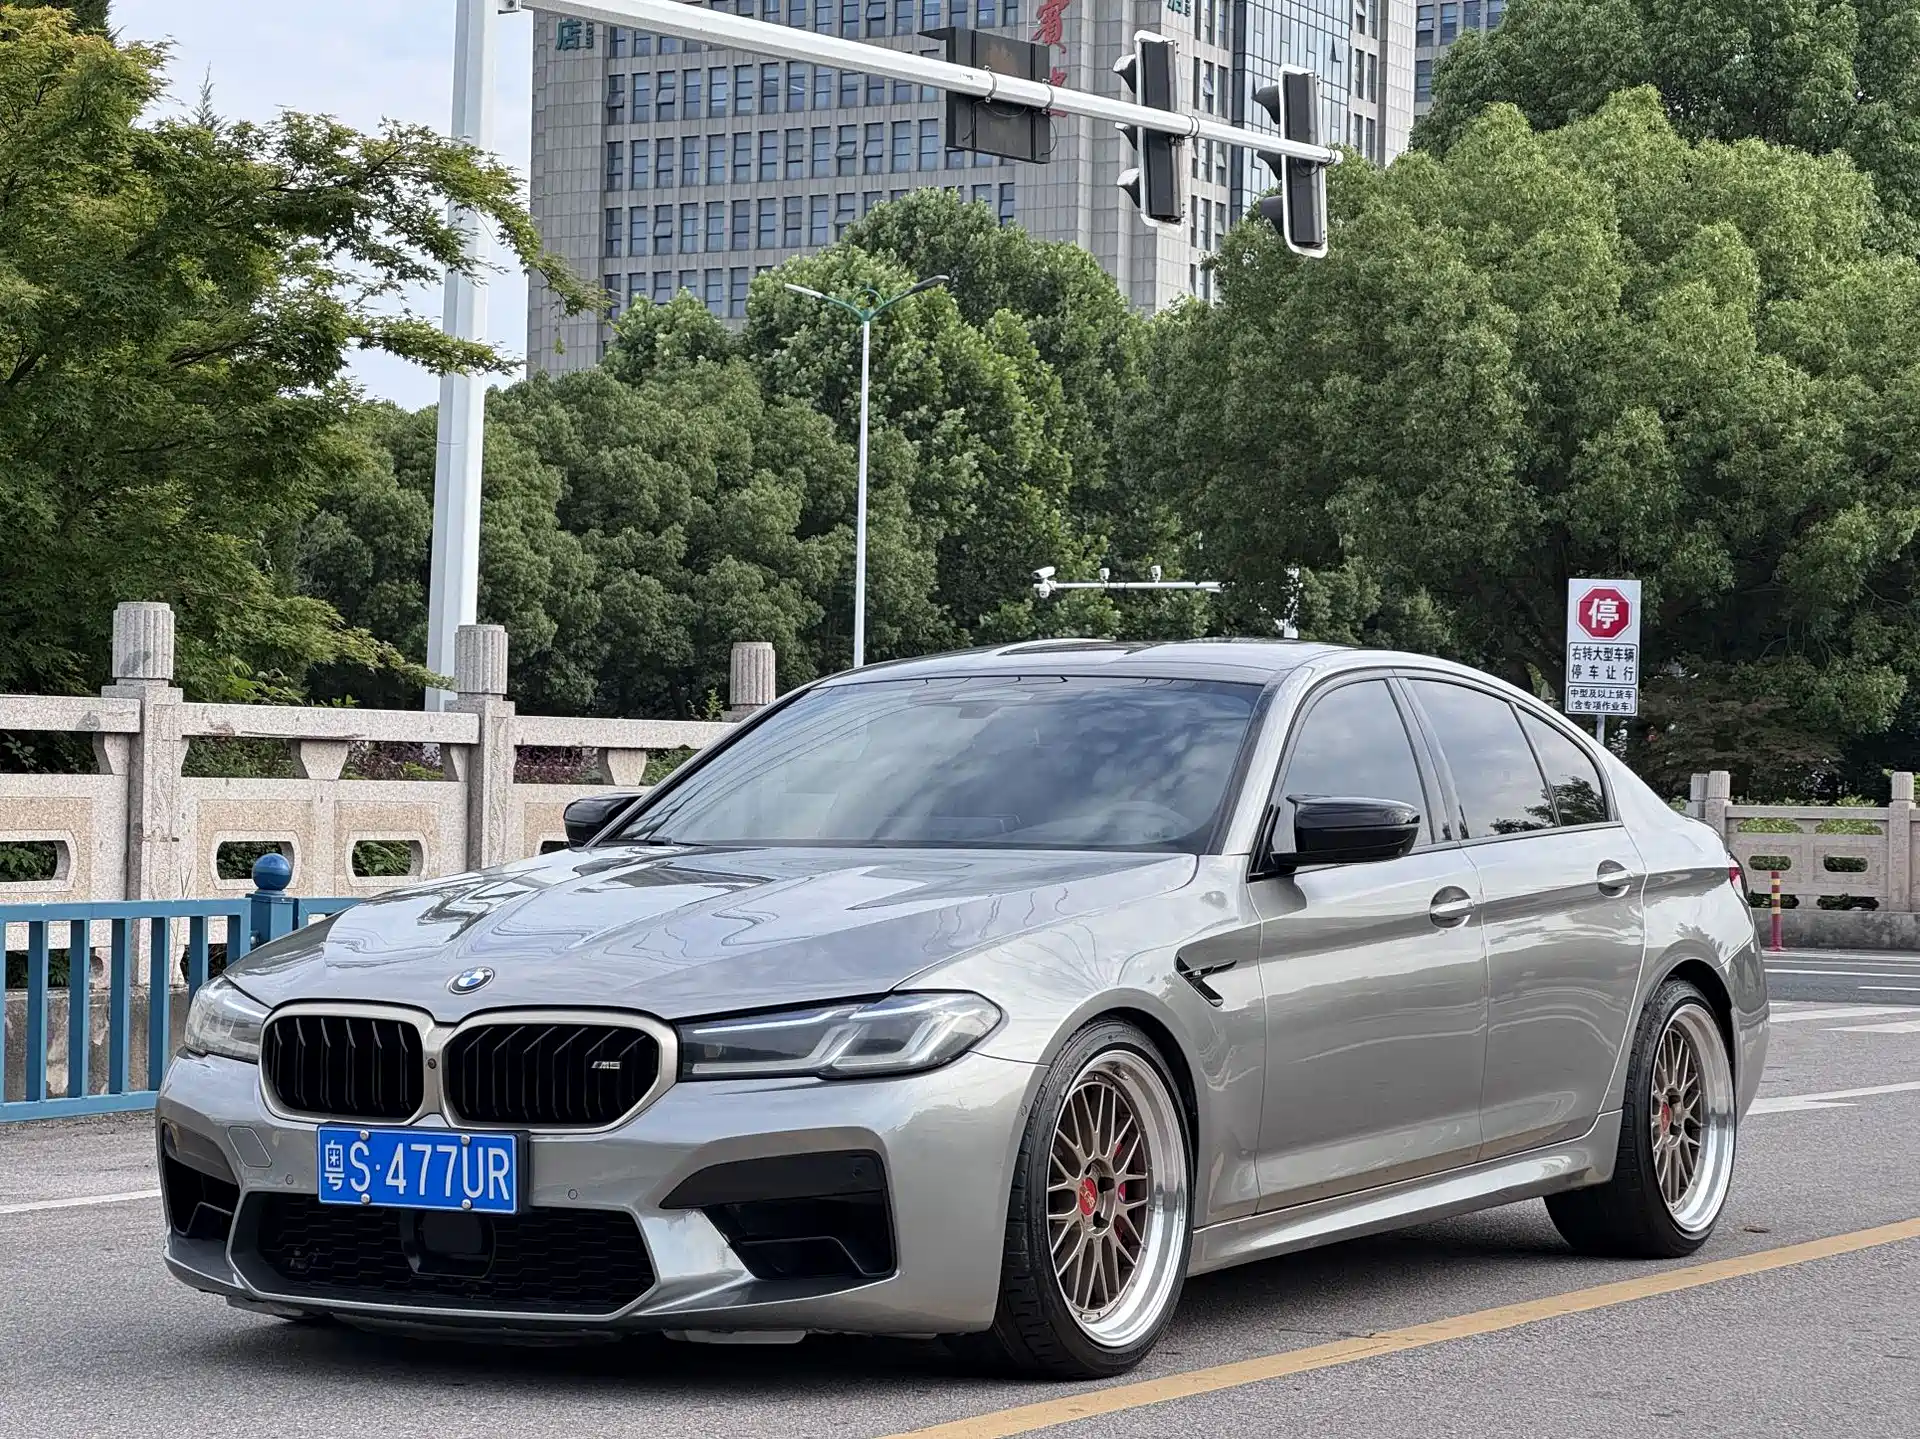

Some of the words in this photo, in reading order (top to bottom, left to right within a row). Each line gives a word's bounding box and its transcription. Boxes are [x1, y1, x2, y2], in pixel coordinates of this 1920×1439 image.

[1588, 598, 1619, 629] 停
[1571, 645, 1635, 662] 右转大型车辆
[1571, 664, 1634, 681] 停车让行
[1570, 688, 1633, 699] 中型及以上货车
